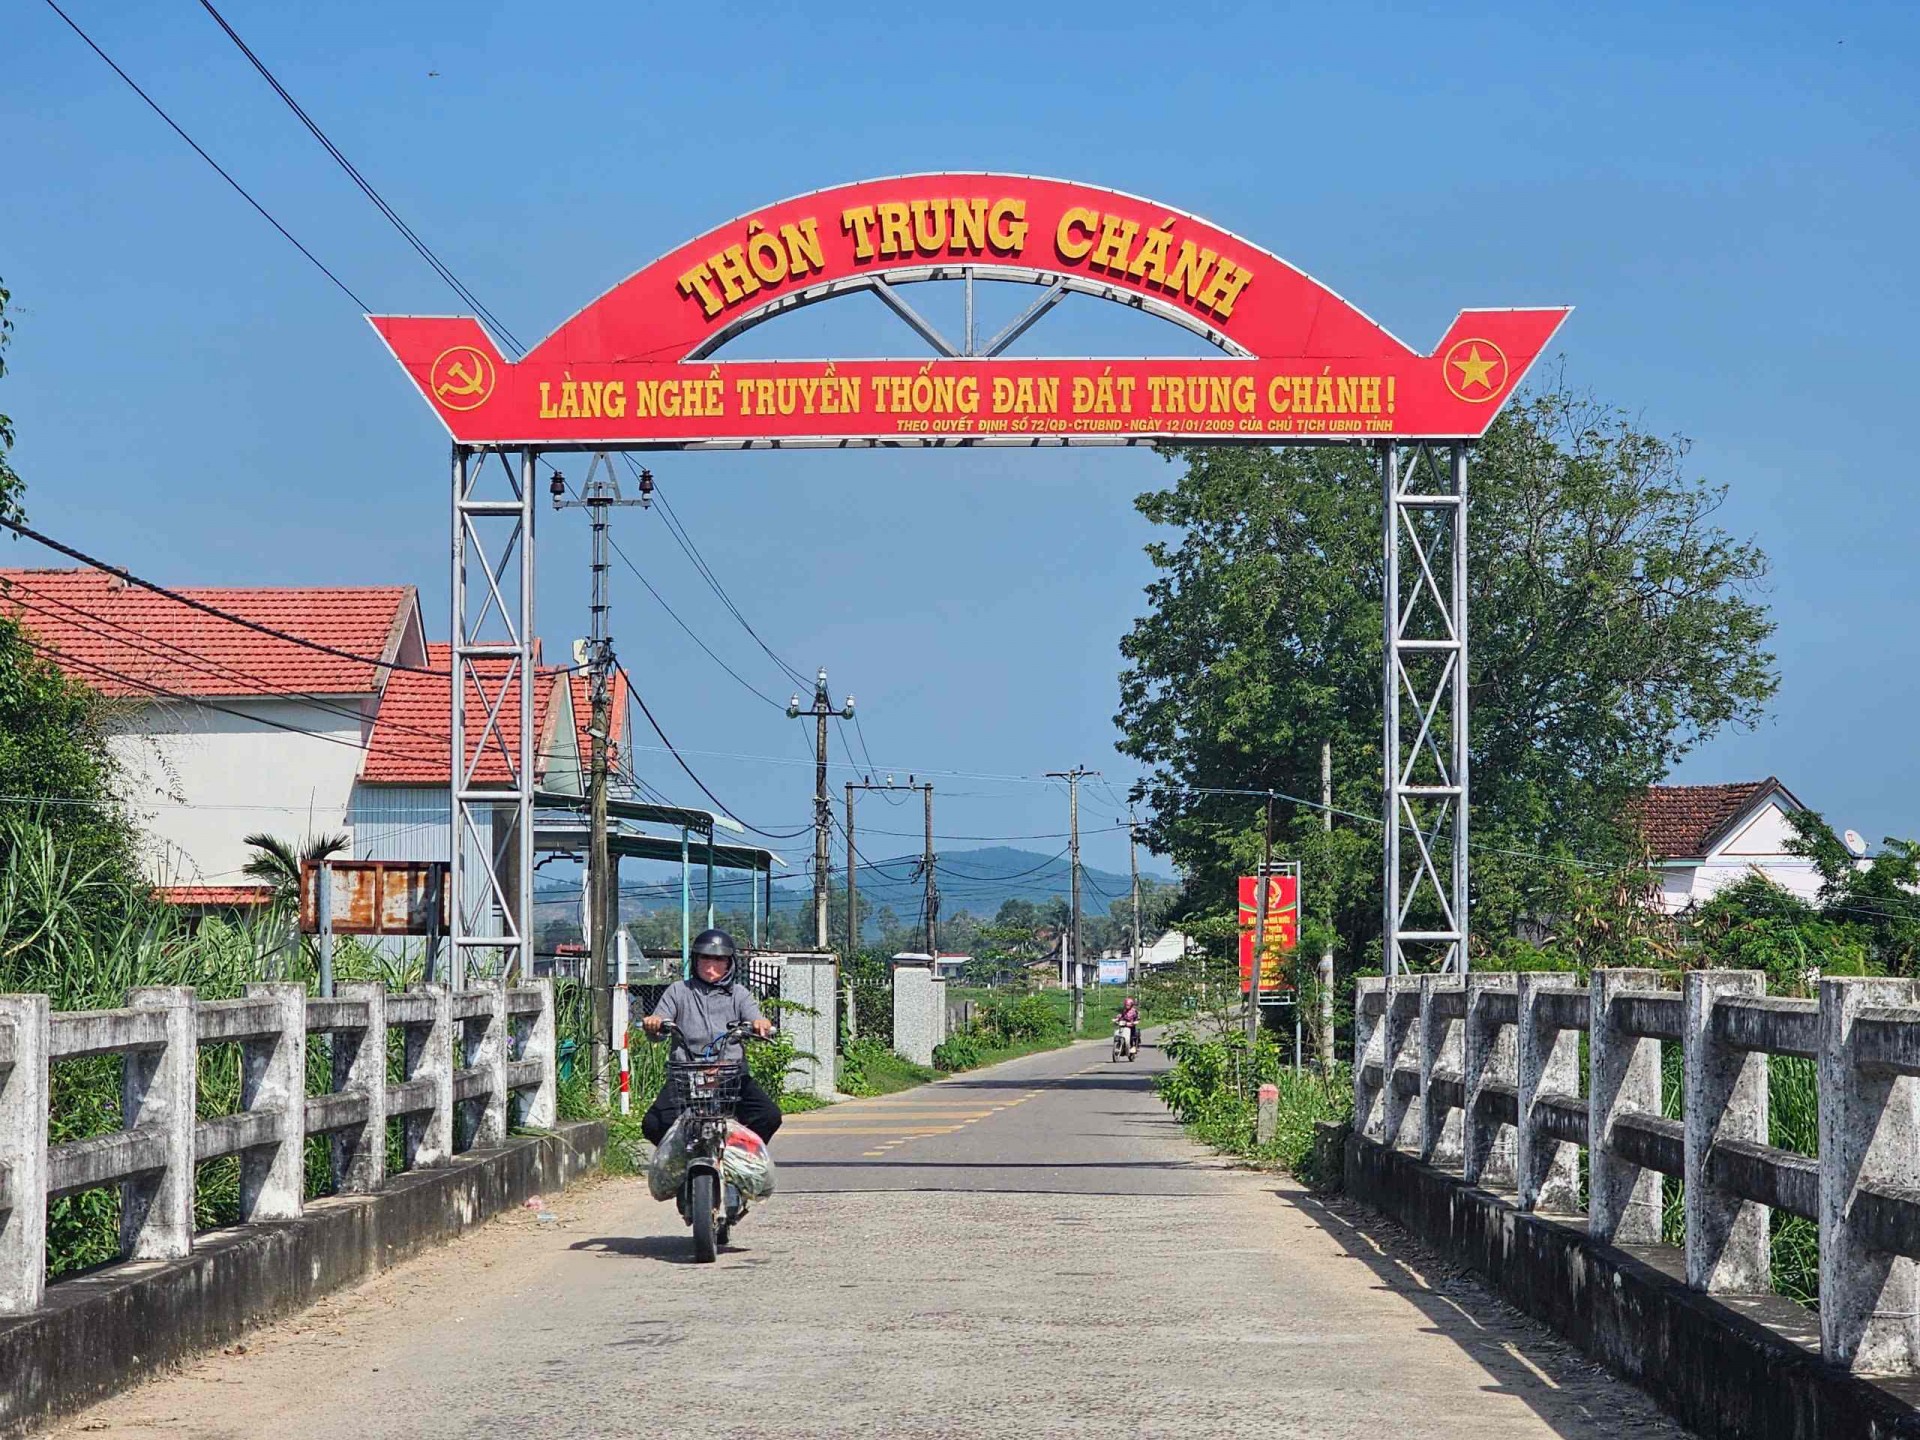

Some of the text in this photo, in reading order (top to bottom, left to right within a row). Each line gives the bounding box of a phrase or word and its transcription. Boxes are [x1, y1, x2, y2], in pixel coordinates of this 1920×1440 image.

[678, 197, 1254, 318] THÔN TRUNG CHÁNH
[539, 361, 1396, 418] LÀNG NGHỀ TRUYỀN THỐNG ĐAN ĐÁT TRUNG CHÁNH!
[897, 419, 929, 431] THEO
[932, 416, 974, 432] QUYẾT
[978, 419, 1008, 434] ĐỊNH
[1011, 416, 1029, 431] SỐ
[1239, 416, 1263, 431] CỦA
[1267, 416, 1293, 431] CHỦ
[1297, 419, 1326, 434] TỊCH
[1329, 419, 1361, 431] UBND
[1365, 416, 1393, 431] TỈNH
